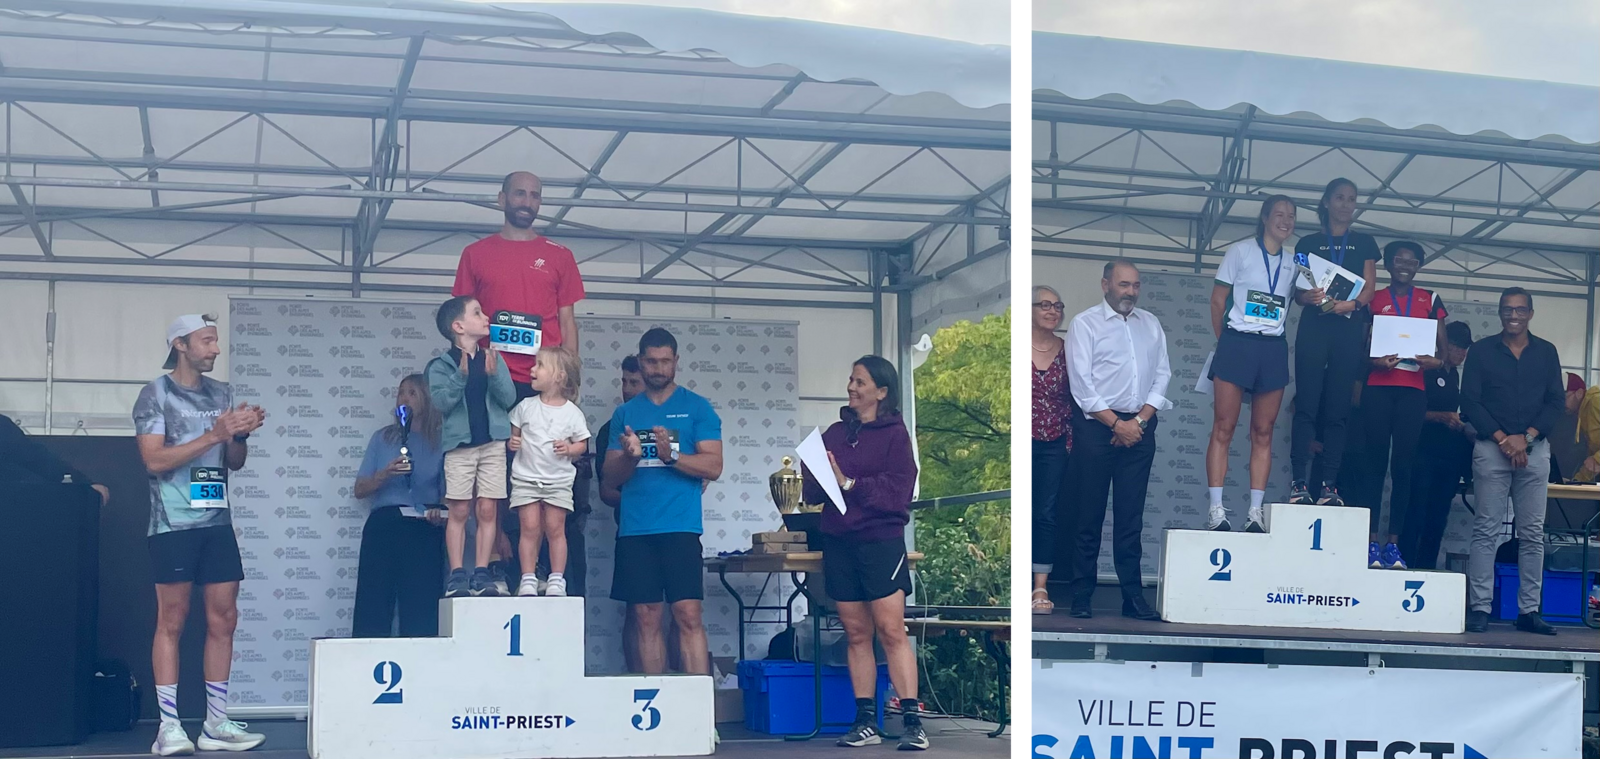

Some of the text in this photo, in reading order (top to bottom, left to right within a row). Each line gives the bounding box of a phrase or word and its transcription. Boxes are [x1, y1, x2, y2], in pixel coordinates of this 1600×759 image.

[1252, 305, 1278, 319] 435
[498, 328, 532, 345] 586
[641, 445, 658, 459] 39
[200, 484, 224, 499] 530
[1308, 518, 1324, 551] 1
[1208, 548, 1232, 582] 2
[1266, 592, 1351, 607] SAINT-PRIEST
[1402, 580, 1426, 613] 3
[503, 614, 524, 657] 1
[372, 660, 404, 705] 2
[465, 706, 501, 714] VILLE DE
[631, 688, 662, 732] 3
[1078, 699, 1217, 728] VILLE DE
[451, 715, 563, 730] SAINT-PRIEST
